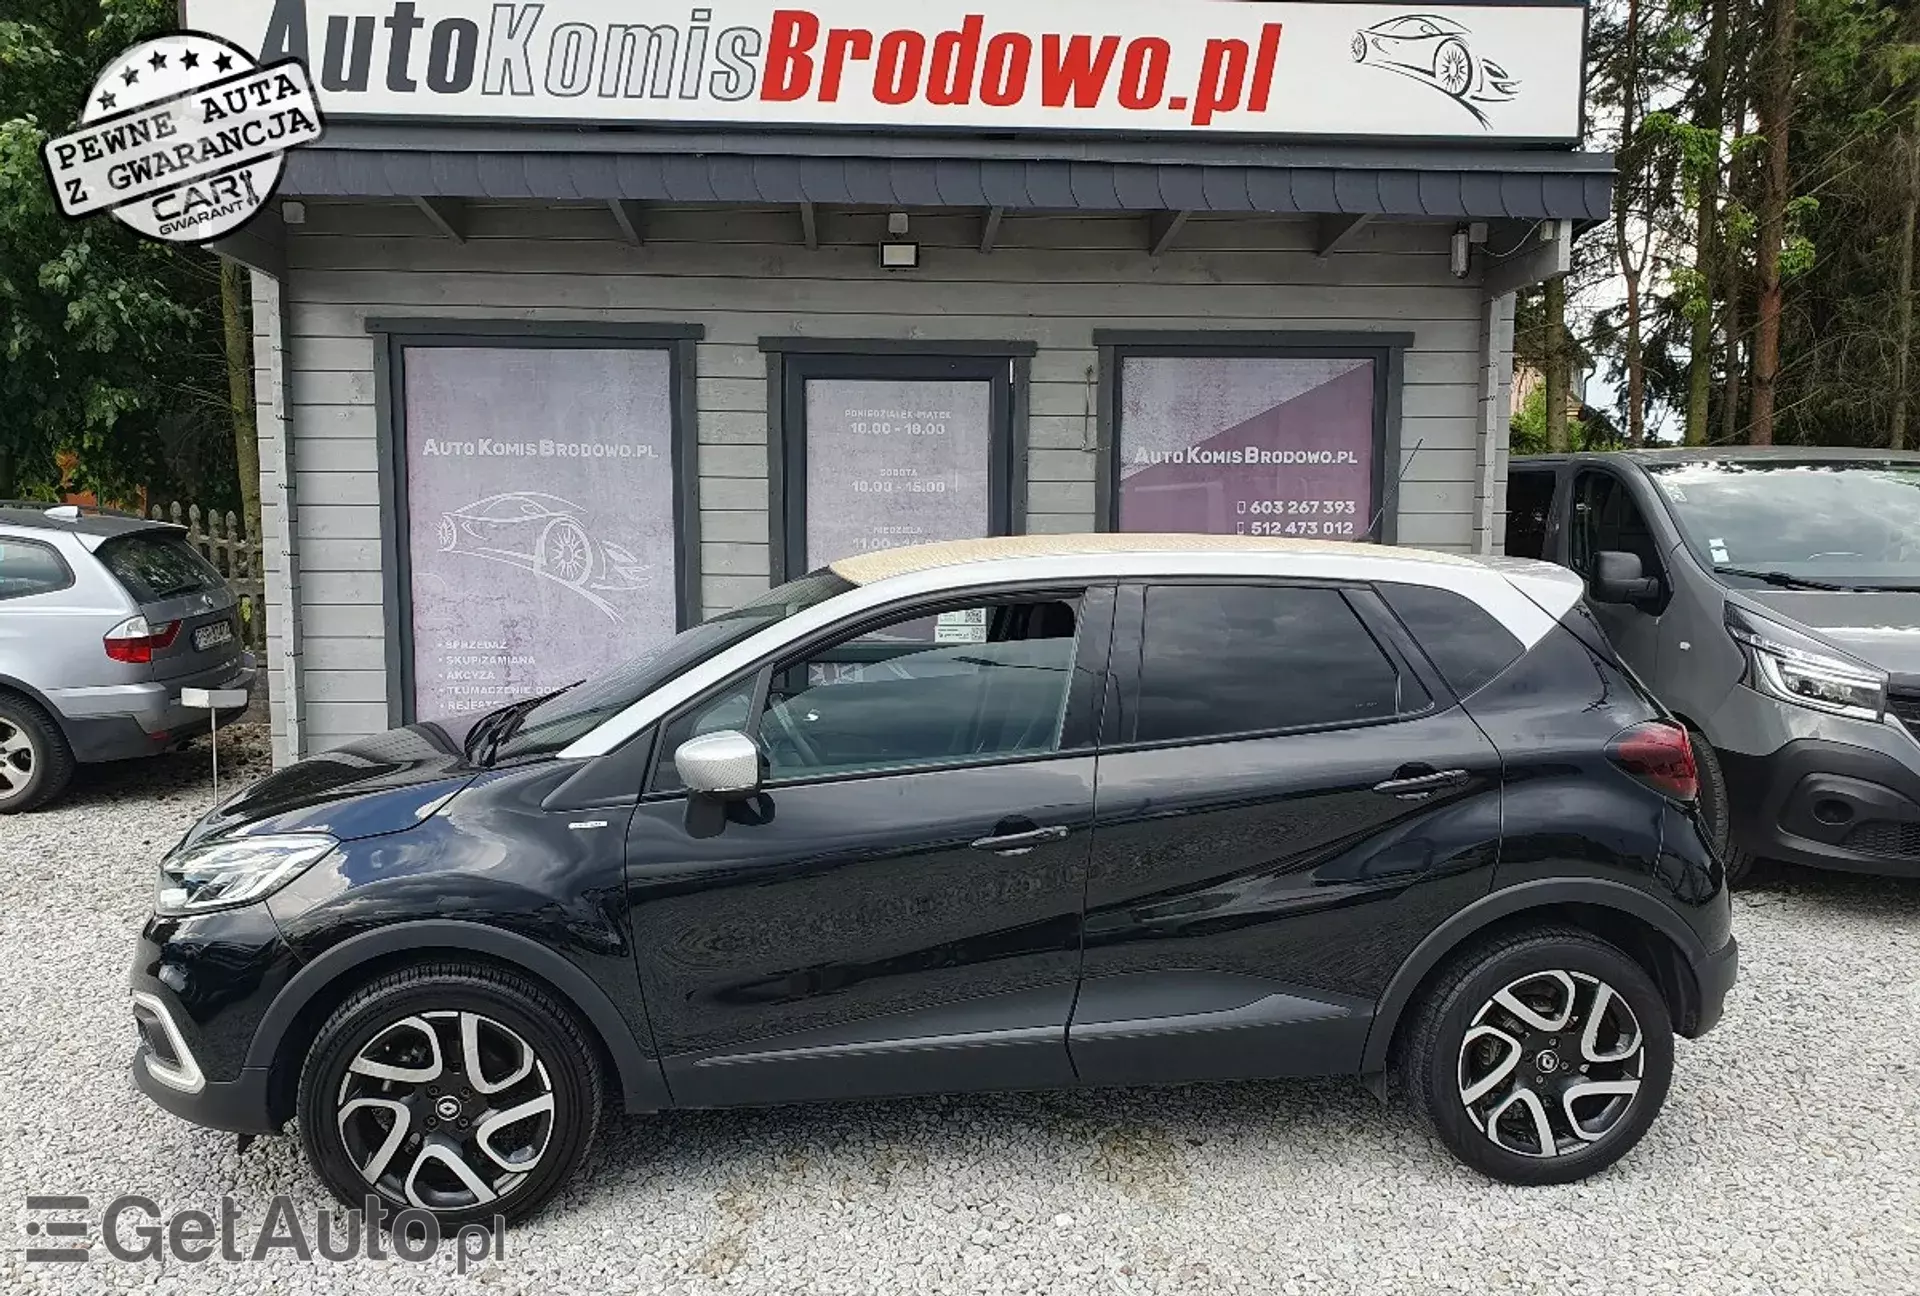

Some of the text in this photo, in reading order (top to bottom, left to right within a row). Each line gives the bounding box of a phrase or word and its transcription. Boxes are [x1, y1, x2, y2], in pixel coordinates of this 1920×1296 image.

[257, 0, 1282, 126] AutoKomisBrodowo.pl
[850, 422, 891, 434] 10.00
[904, 423, 945, 435] 18.00
[851, 480, 892, 492] 10.00
[1249, 501, 1356, 514] 603 267 393
[1251, 521, 1354, 535] 512 473 012
[446, 670, 495, 680] AKCYZA
